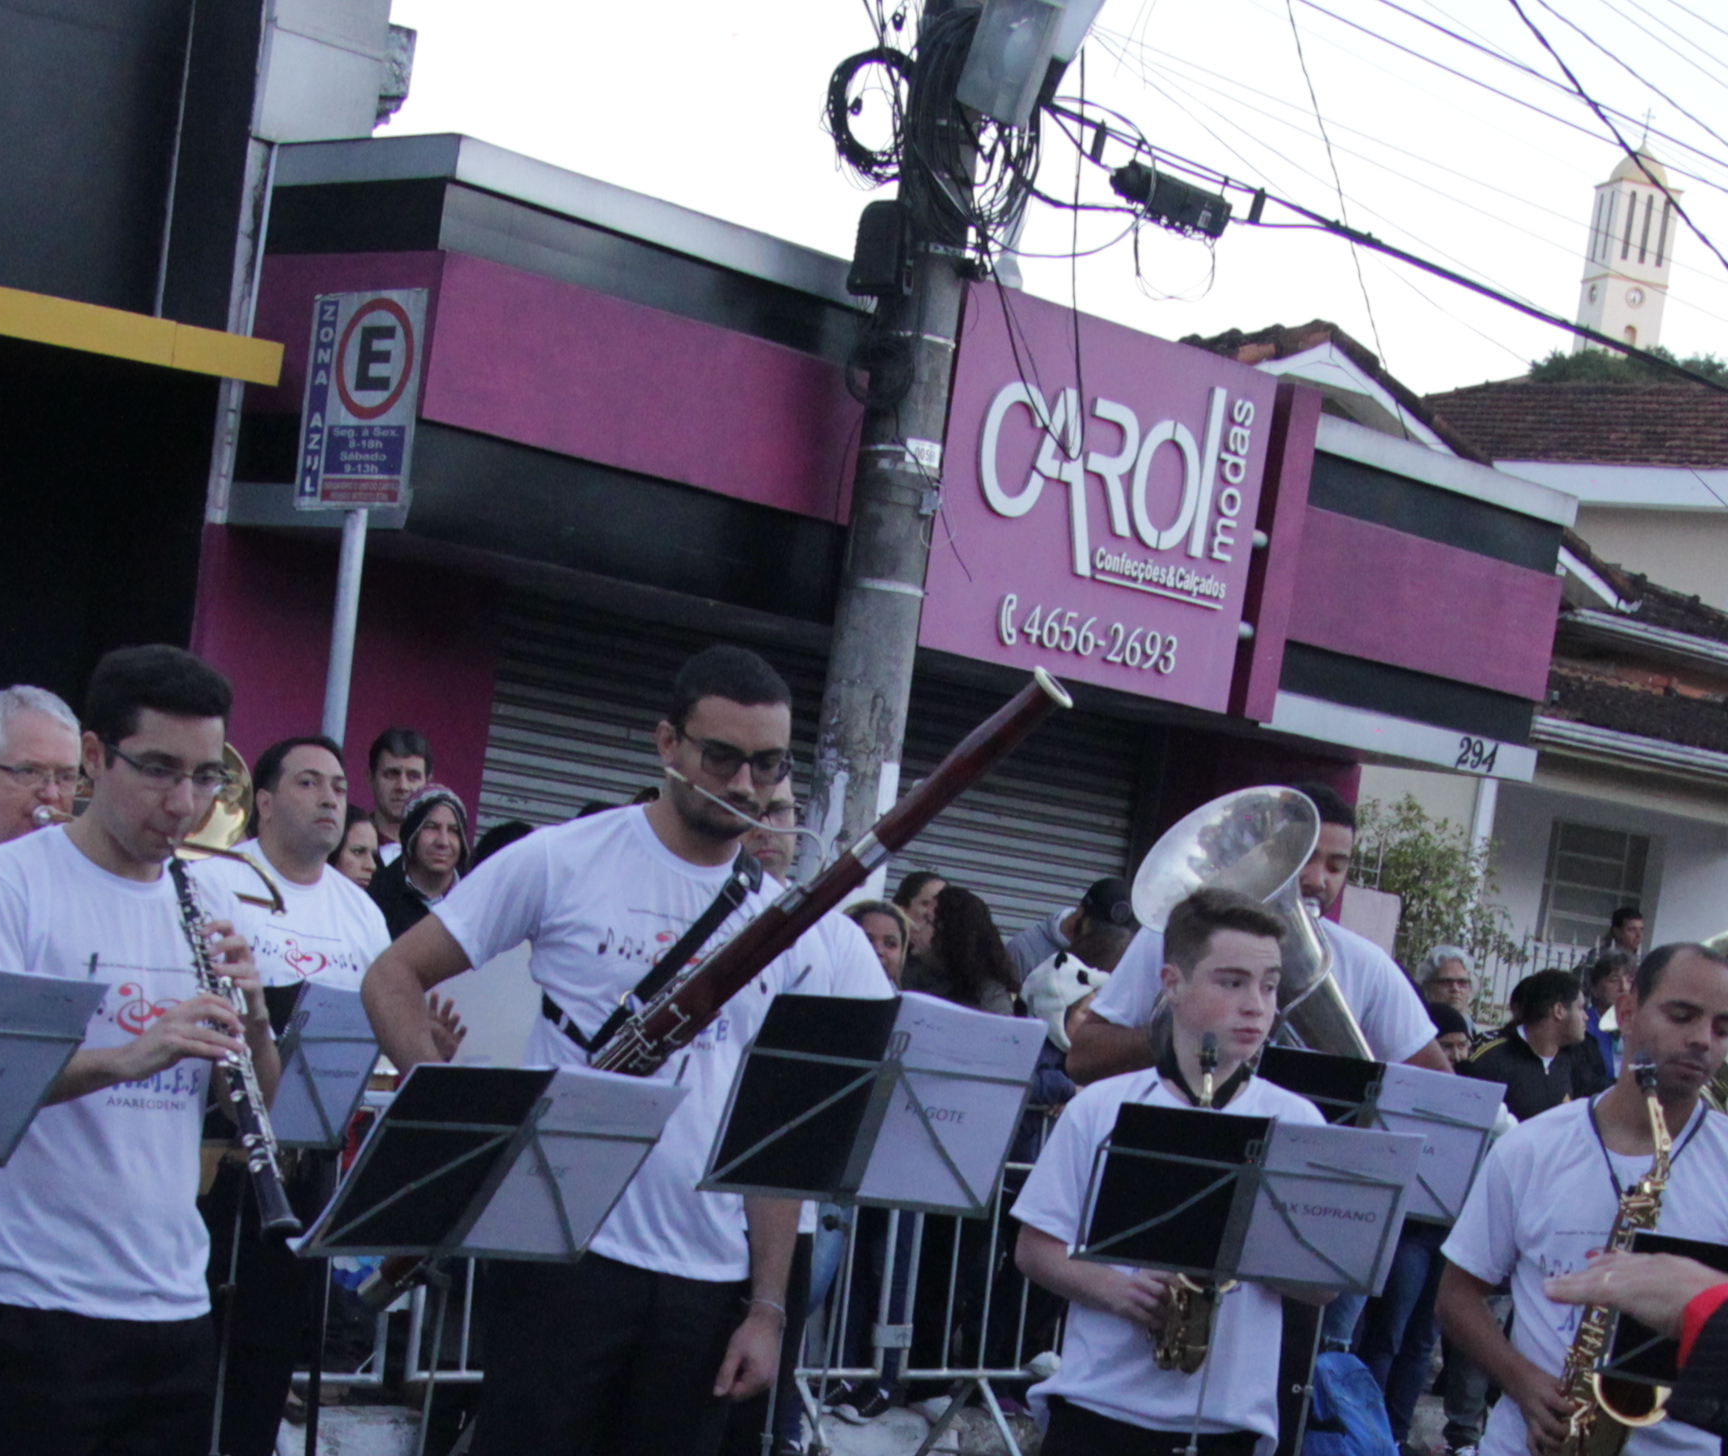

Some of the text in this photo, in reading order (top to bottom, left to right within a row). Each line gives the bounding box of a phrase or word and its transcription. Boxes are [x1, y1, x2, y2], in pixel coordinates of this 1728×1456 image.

[314, 305, 336, 386] ZONA
[354, 326, 396, 391] E
[304, 411, 323, 493] AZUL
[339, 451, 387, 462] Sábado
[373, 427, 399, 437] Sex.
[344, 464, 379, 474] 9-13h
[1210, 399, 1255, 562] modas
[1022, 604, 1178, 675] 4656-2693
[1455, 736, 1500, 773] 294
[1303, 1203, 1377, 1223] SOPRANO
